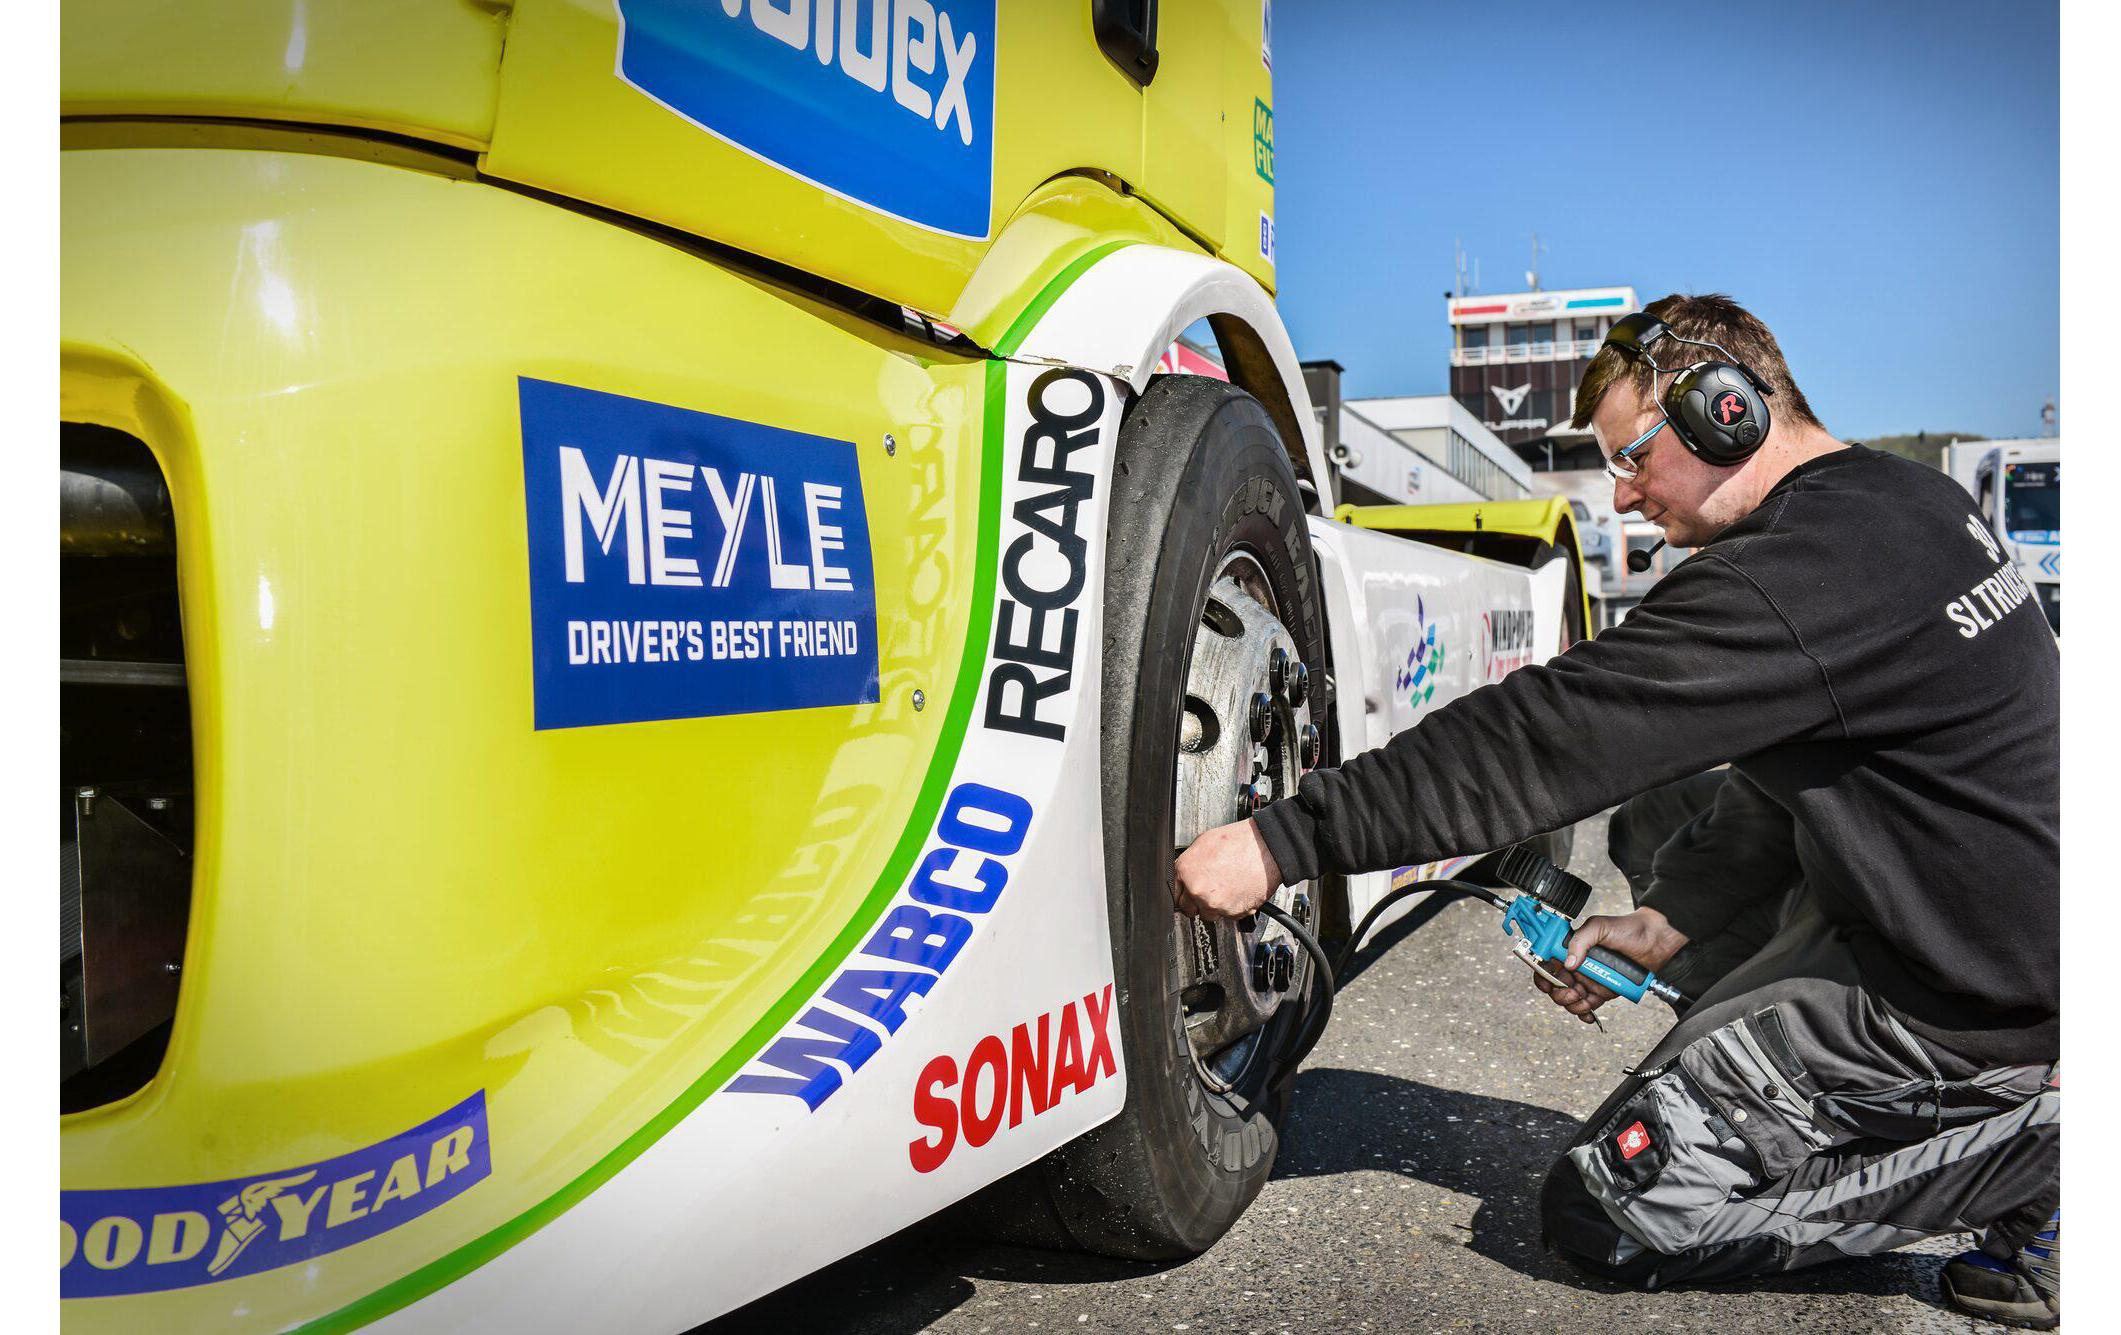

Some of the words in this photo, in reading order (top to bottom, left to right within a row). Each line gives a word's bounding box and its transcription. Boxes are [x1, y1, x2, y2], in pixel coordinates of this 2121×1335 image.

[1256, 140, 1274, 180] FIL
[558, 445, 854, 592] MEYLE
[984, 367, 1105, 742] RECARO
[567, 620, 704, 665] DRIVER'S
[711, 620, 773, 660] BEST
[779, 620, 858, 658] FRIEND
[721, 782, 1034, 1113] WABCO
[909, 983, 1117, 1174] SONAX
